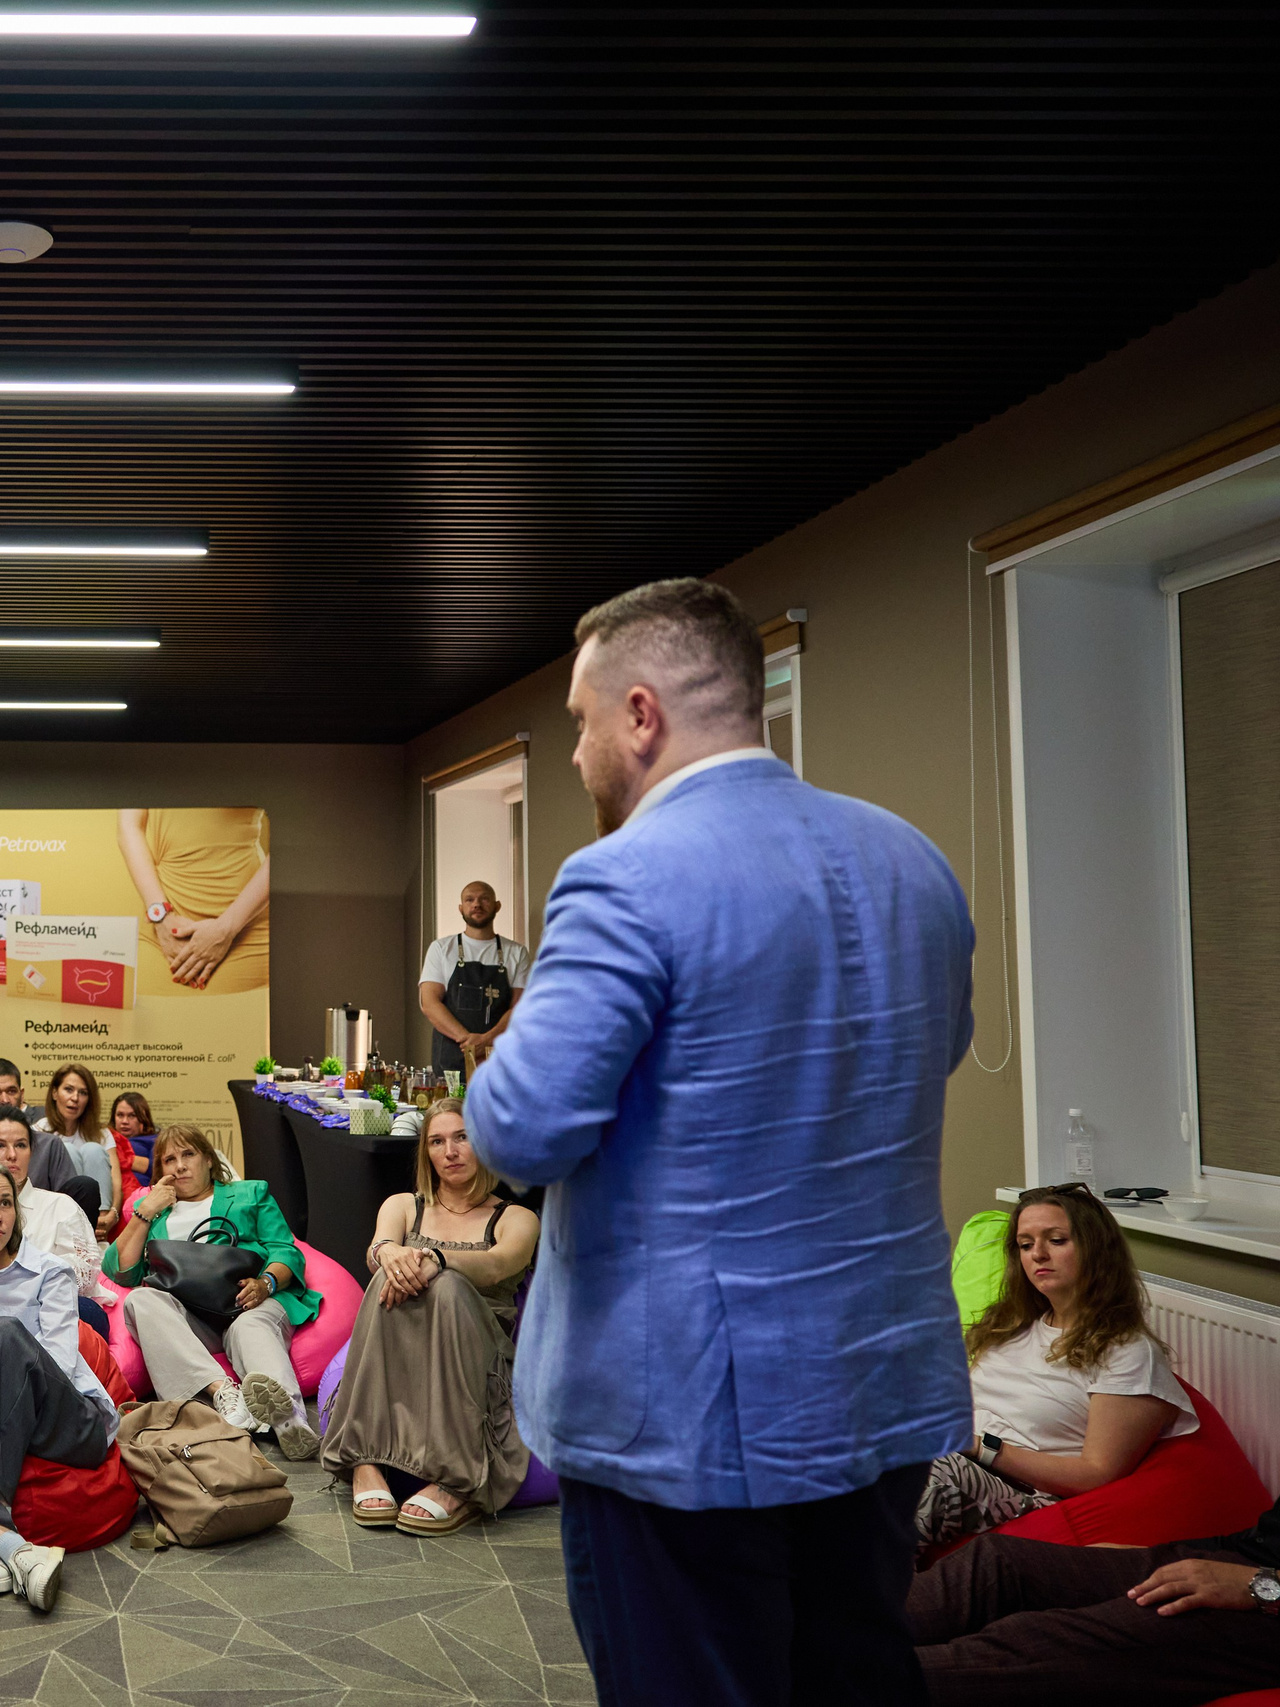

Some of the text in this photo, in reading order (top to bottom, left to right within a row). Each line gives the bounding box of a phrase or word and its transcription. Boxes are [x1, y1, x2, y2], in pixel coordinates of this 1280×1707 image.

[31, 1040, 183, 1052] фосфомицин обладает высокой
[31, 1053, 124, 1063] чувствительностью
[134, 1053, 205, 1063] уропатогенной
[207, 1054, 215, 1063] E.
[127, 1070, 178, 1079] пациентов
